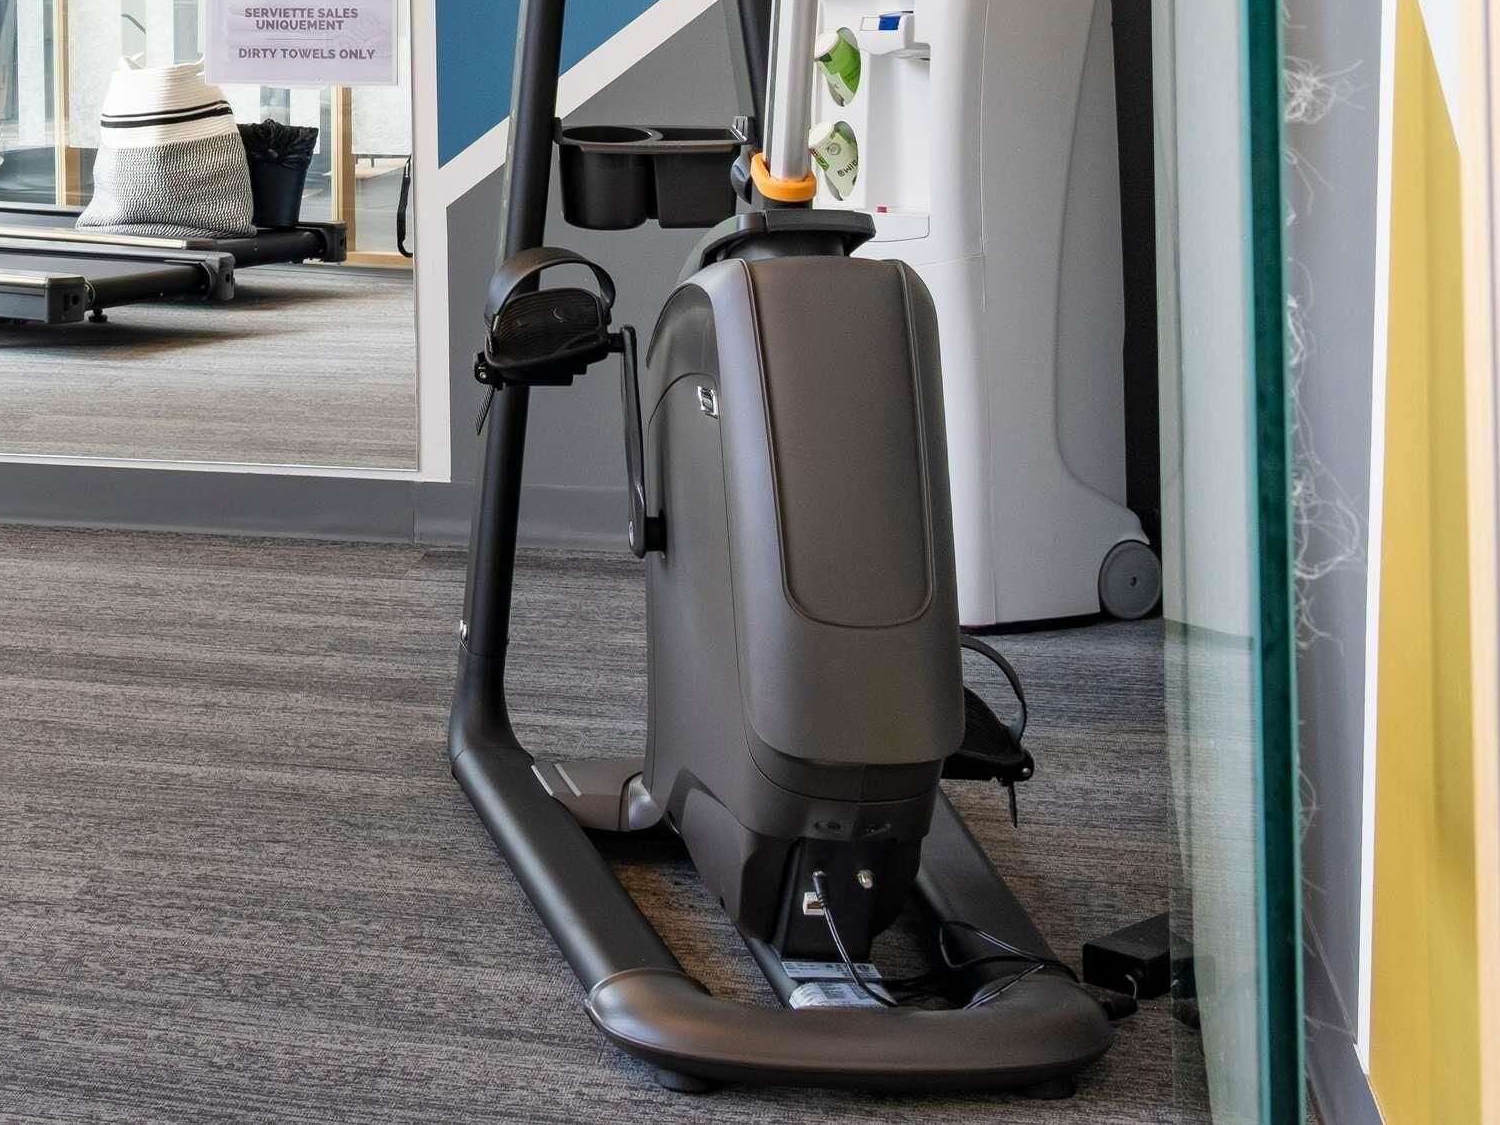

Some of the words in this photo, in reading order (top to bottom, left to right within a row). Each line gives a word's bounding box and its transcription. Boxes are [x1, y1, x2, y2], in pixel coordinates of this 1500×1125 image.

[244, 7, 315, 19] SERVIETTE
[317, 7, 359, 19] SALES
[255, 19, 345, 31] UNIQUEMENT
[238, 48, 277, 59] DIRTY
[280, 48, 336, 59] TOWELS
[338, 49, 376, 60] ONLY
